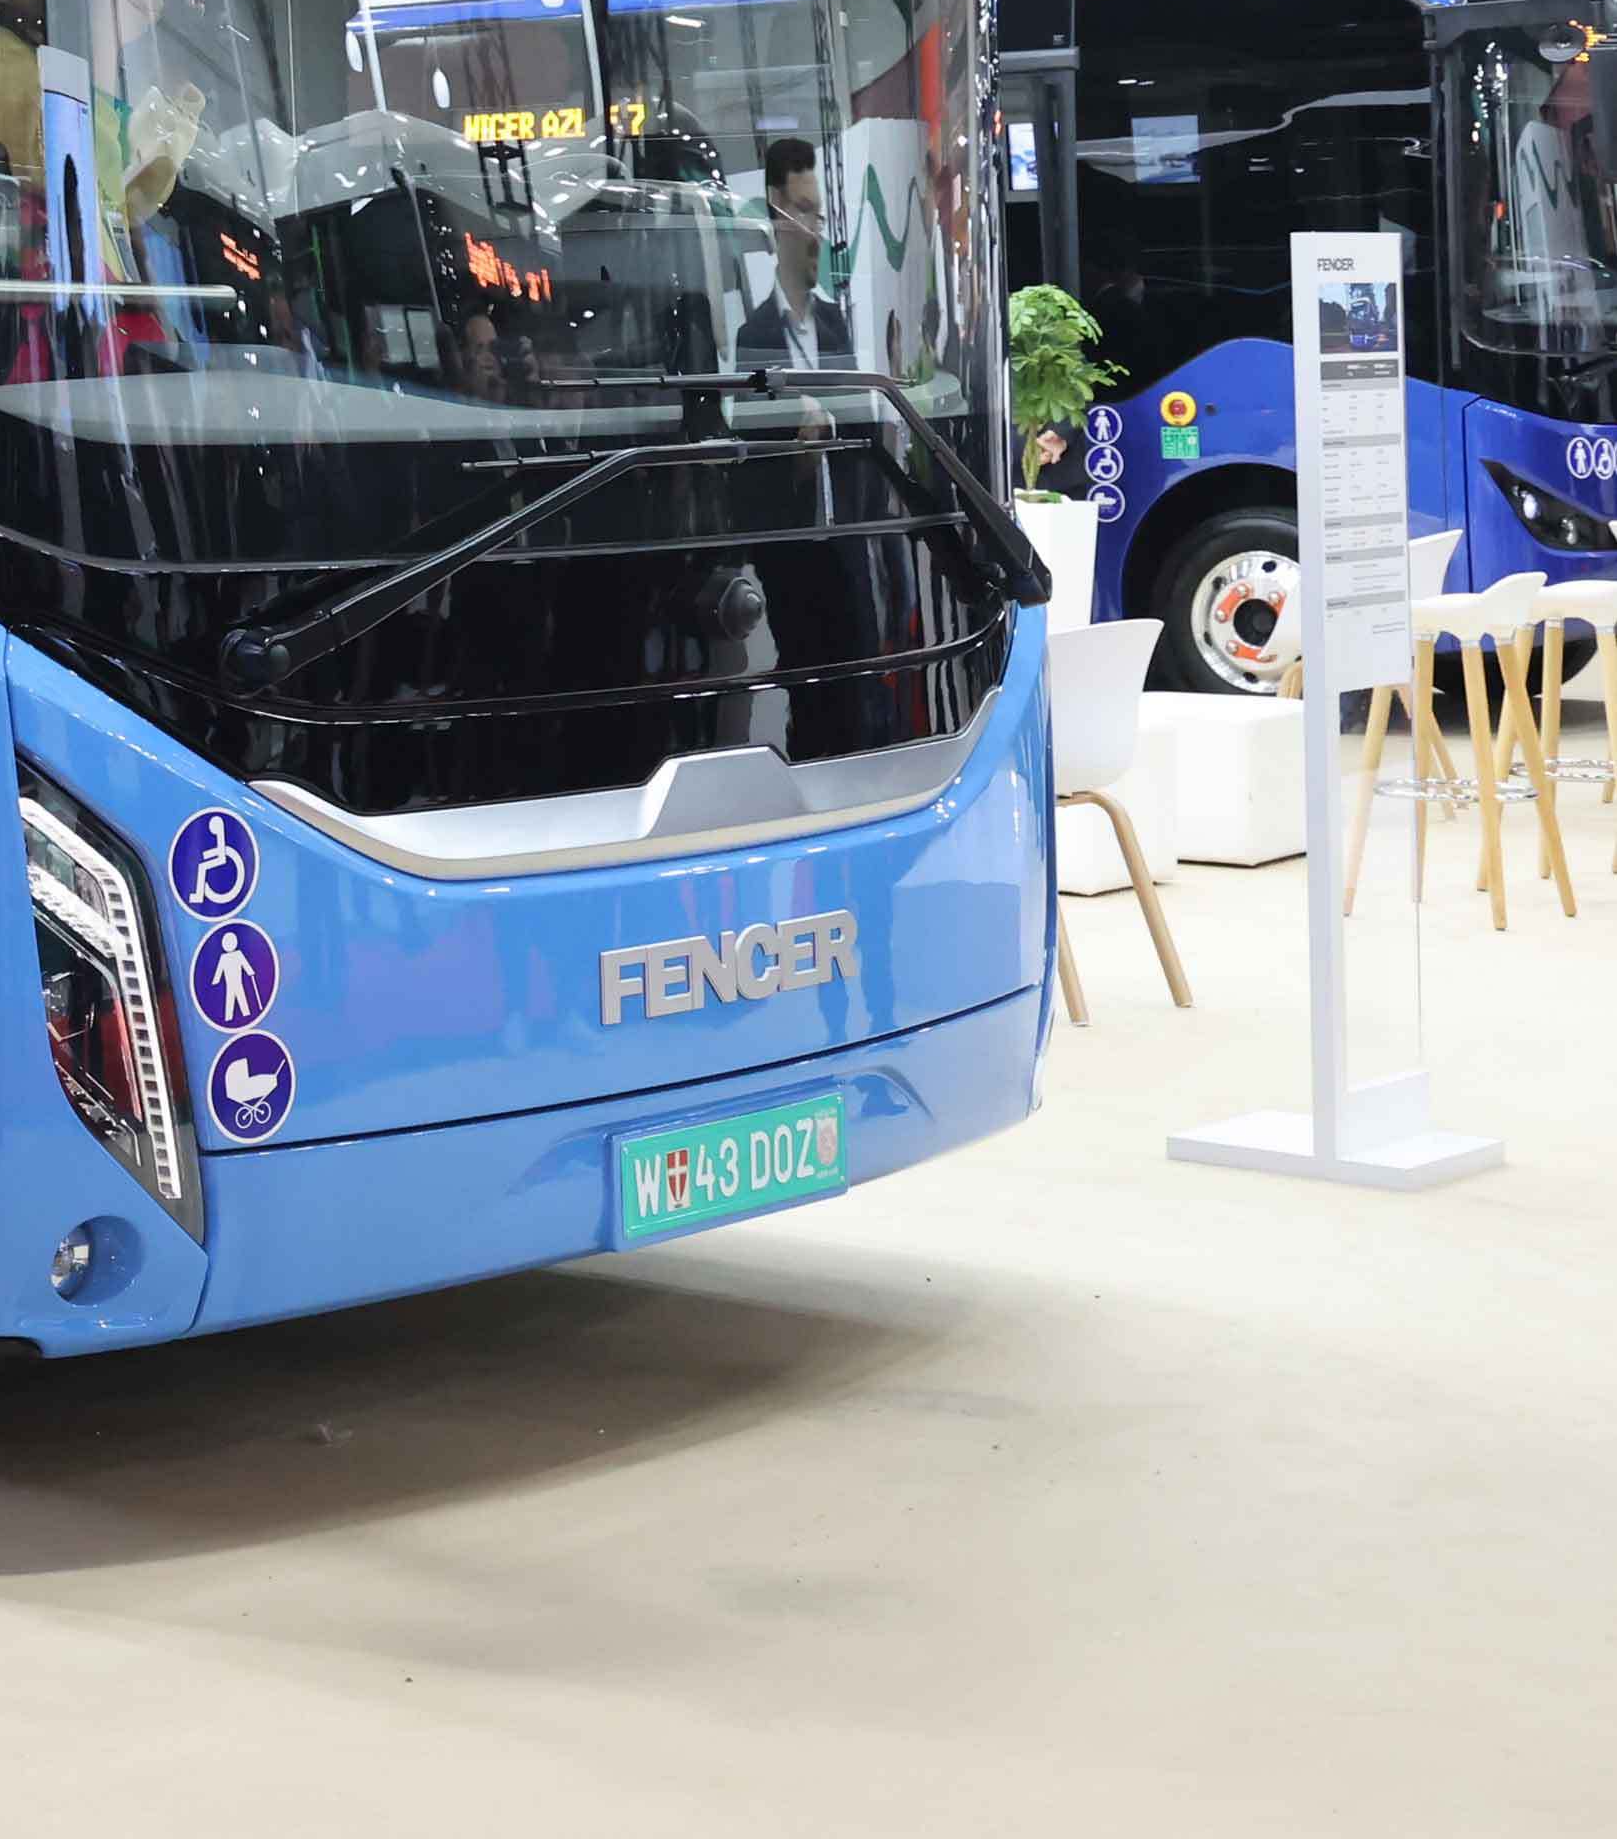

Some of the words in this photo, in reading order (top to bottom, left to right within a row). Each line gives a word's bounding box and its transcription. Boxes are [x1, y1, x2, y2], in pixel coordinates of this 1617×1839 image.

[1317, 258, 1354, 272] FENCER
[600, 909, 859, 1025] FENCER
[635, 1153, 663, 1217] W
[695, 1136, 741, 1202] 43
